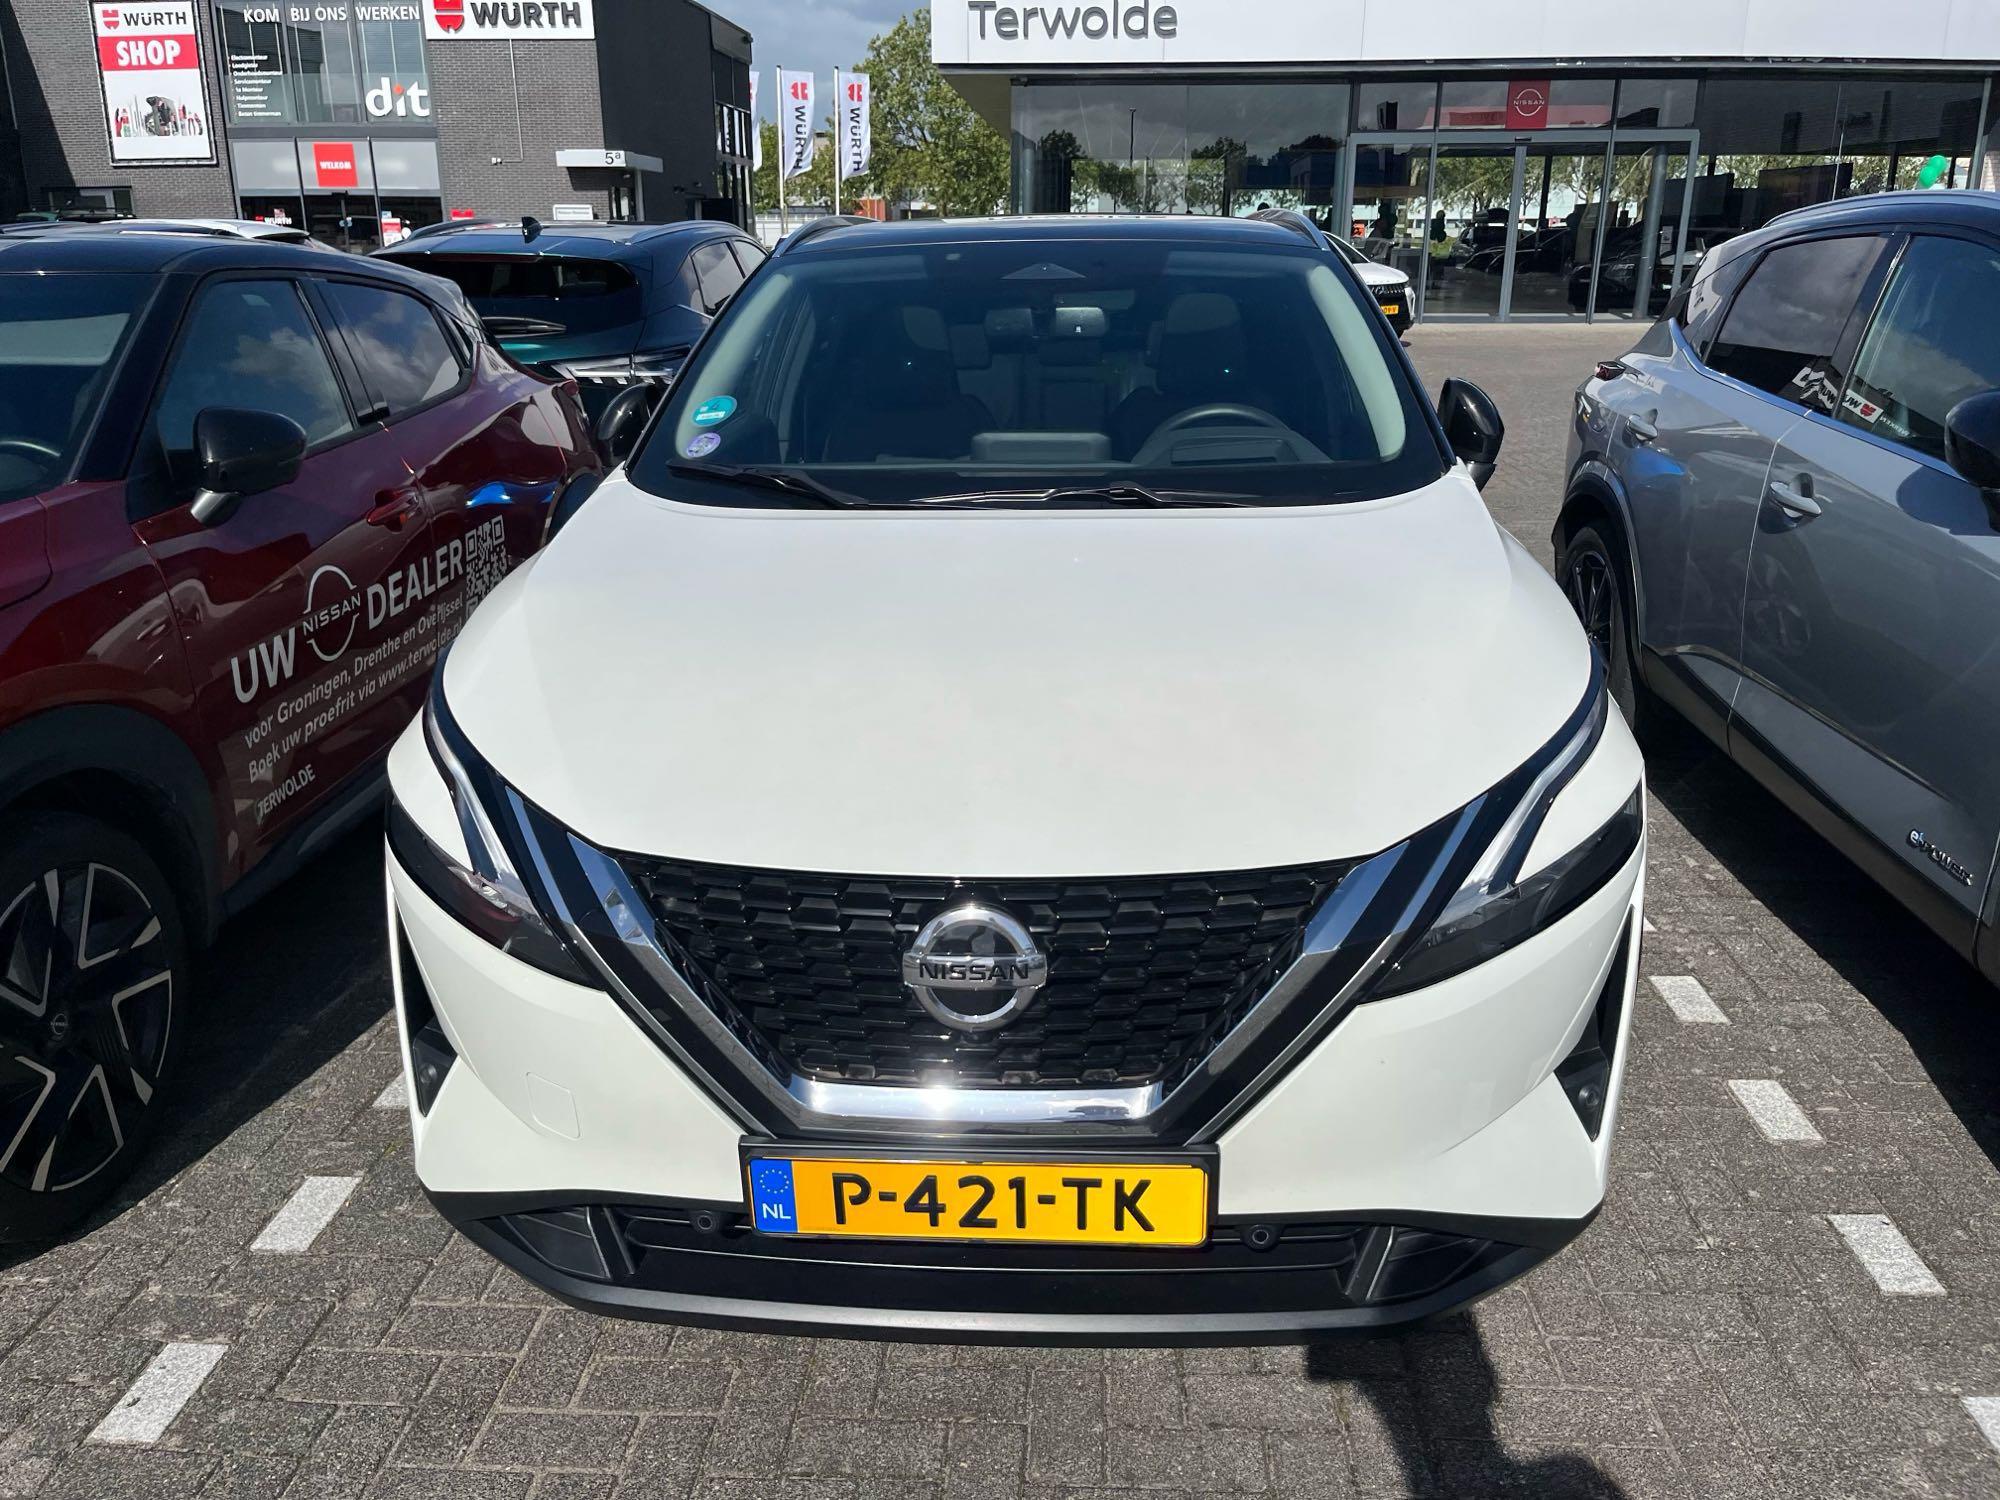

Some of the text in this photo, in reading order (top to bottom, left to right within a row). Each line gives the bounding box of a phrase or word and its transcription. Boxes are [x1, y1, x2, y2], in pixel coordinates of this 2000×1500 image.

[123, 11, 187, 26] WÜRTH
[243, 6, 420, 23] KOM BIJ ONS WERKEN
[470, 2, 582, 28] WÜRTH
[968, 0, 1178, 40] Terwolde
[116, 39, 180, 66] SHOP
[365, 76, 431, 117] dit
[849, 107, 863, 172] WÜRTH
[319, 161, 352, 170] WELKOM
[231, 538, 463, 703] UW NISSAN DEALER
[245, 592, 463, 749] voor Groningen, Drenthe en Overijssel
[249, 742, 281, 784] Boek
[281, 728, 302, 753] uw
[304, 690, 356, 743] proefrit
[358, 679, 377, 701] via
[919, 962, 1029, 981] NISSAN
[762, 1203, 792, 1221] NL
[831, 1172, 1155, 1232] P-421-TK
